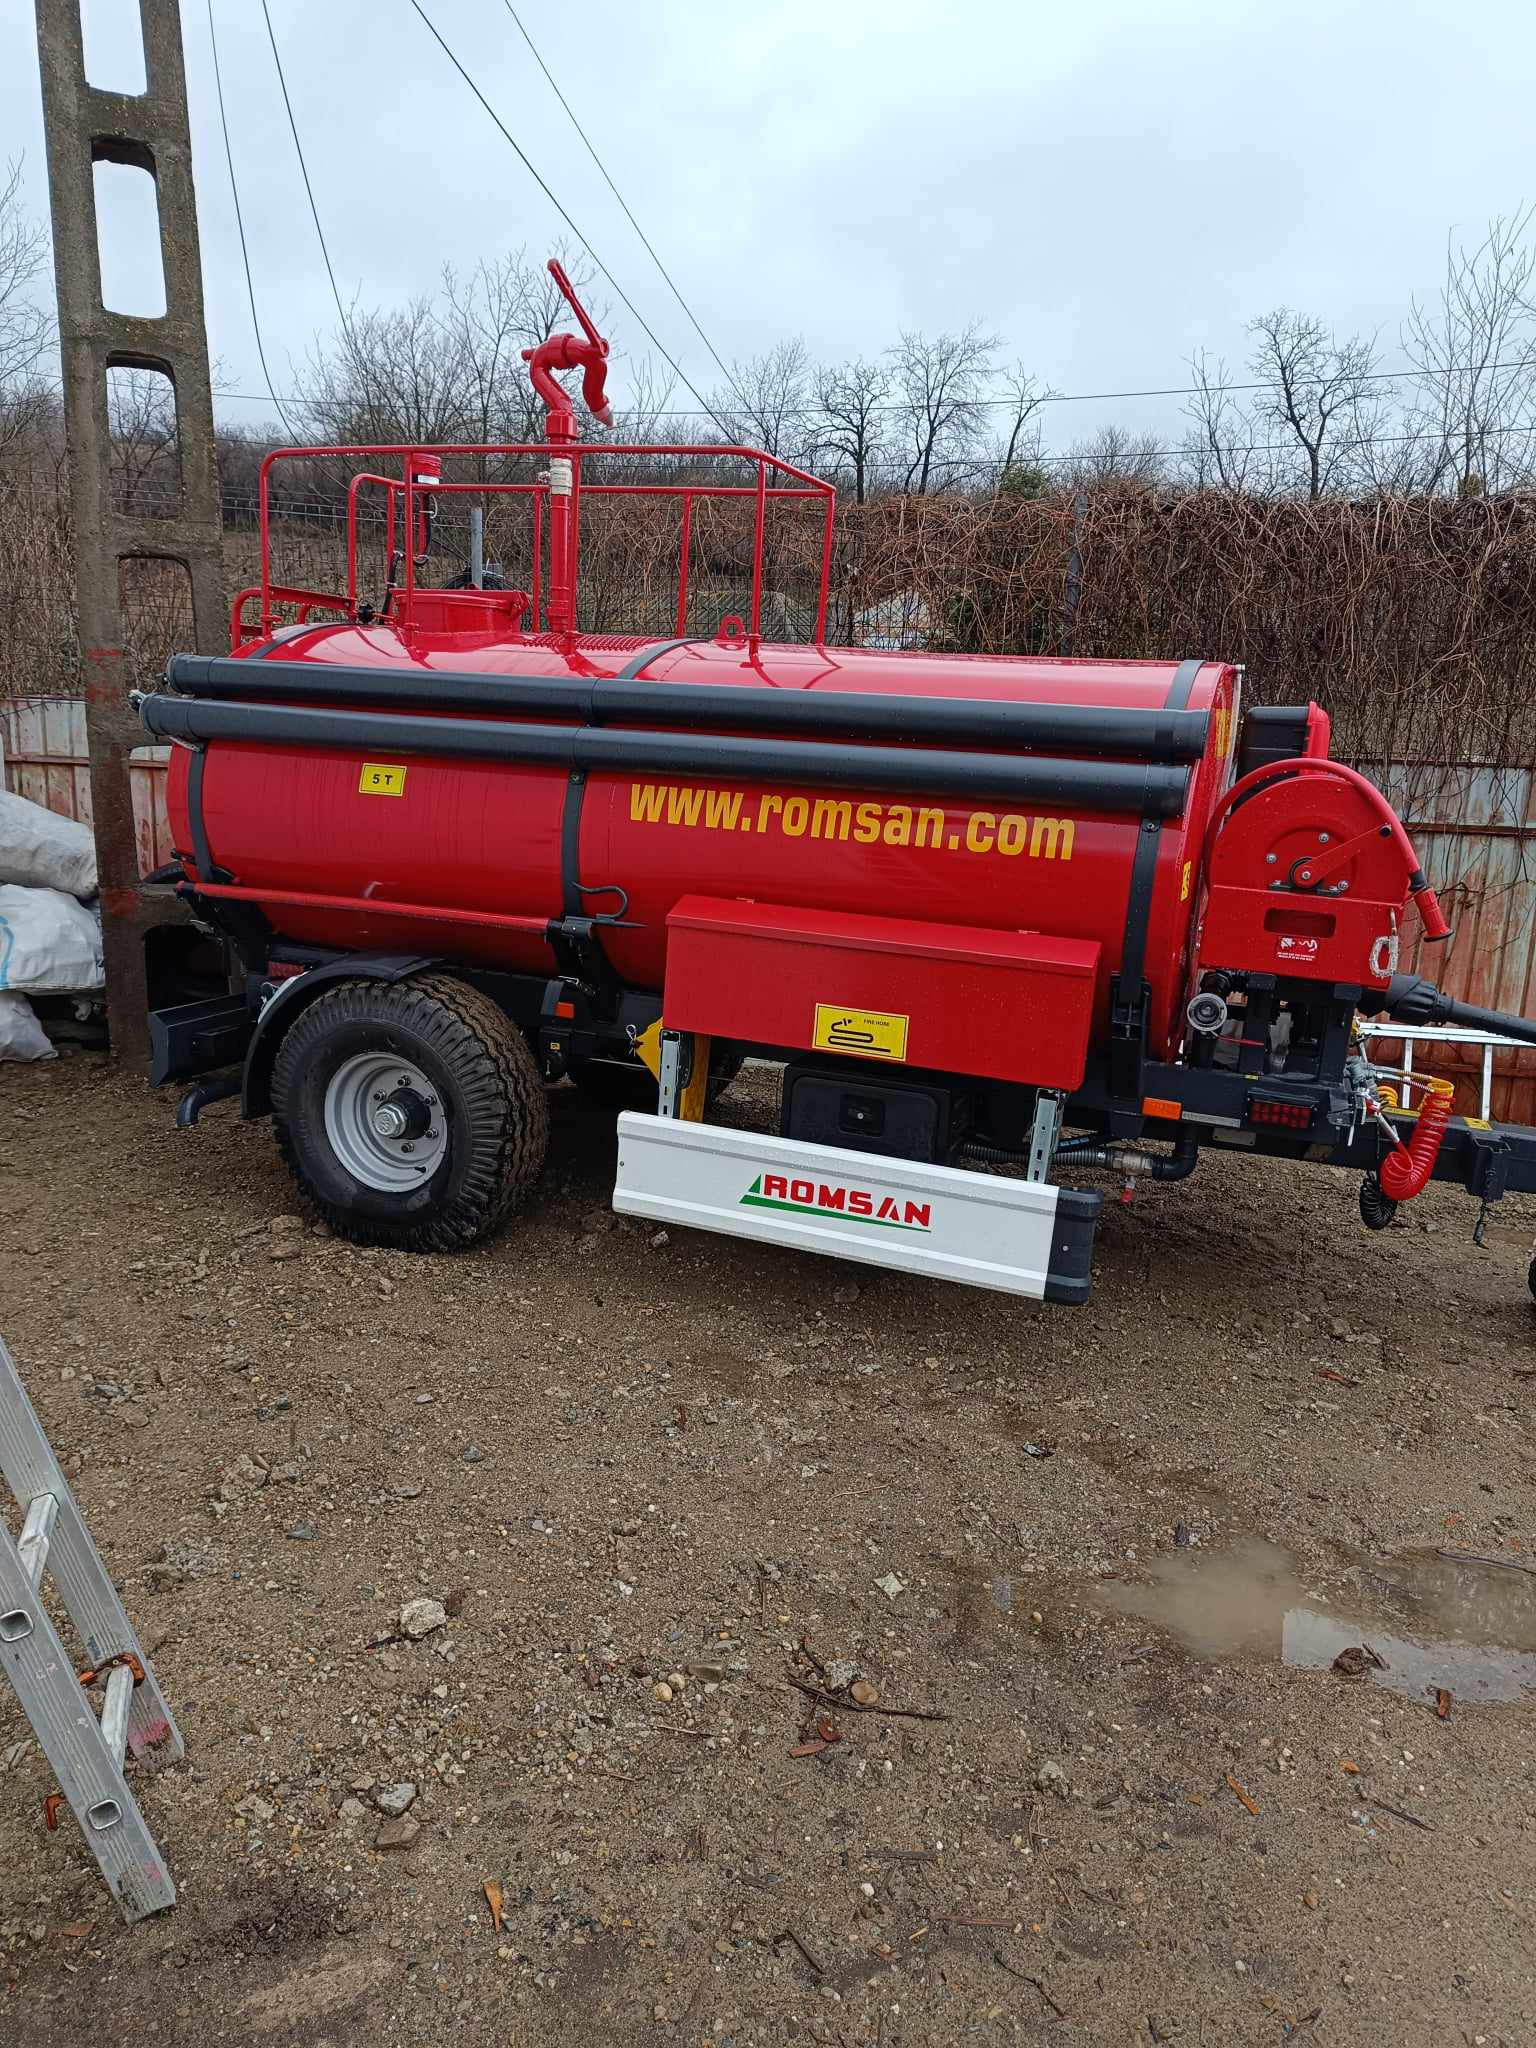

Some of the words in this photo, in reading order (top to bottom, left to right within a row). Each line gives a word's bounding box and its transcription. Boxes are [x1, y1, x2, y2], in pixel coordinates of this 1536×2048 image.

[372, 773, 380, 785] 5
[384, 774, 393, 785] T
[630, 783, 1075, 860] www.romsan.com
[764, 1174, 931, 1227] ROMSAN
